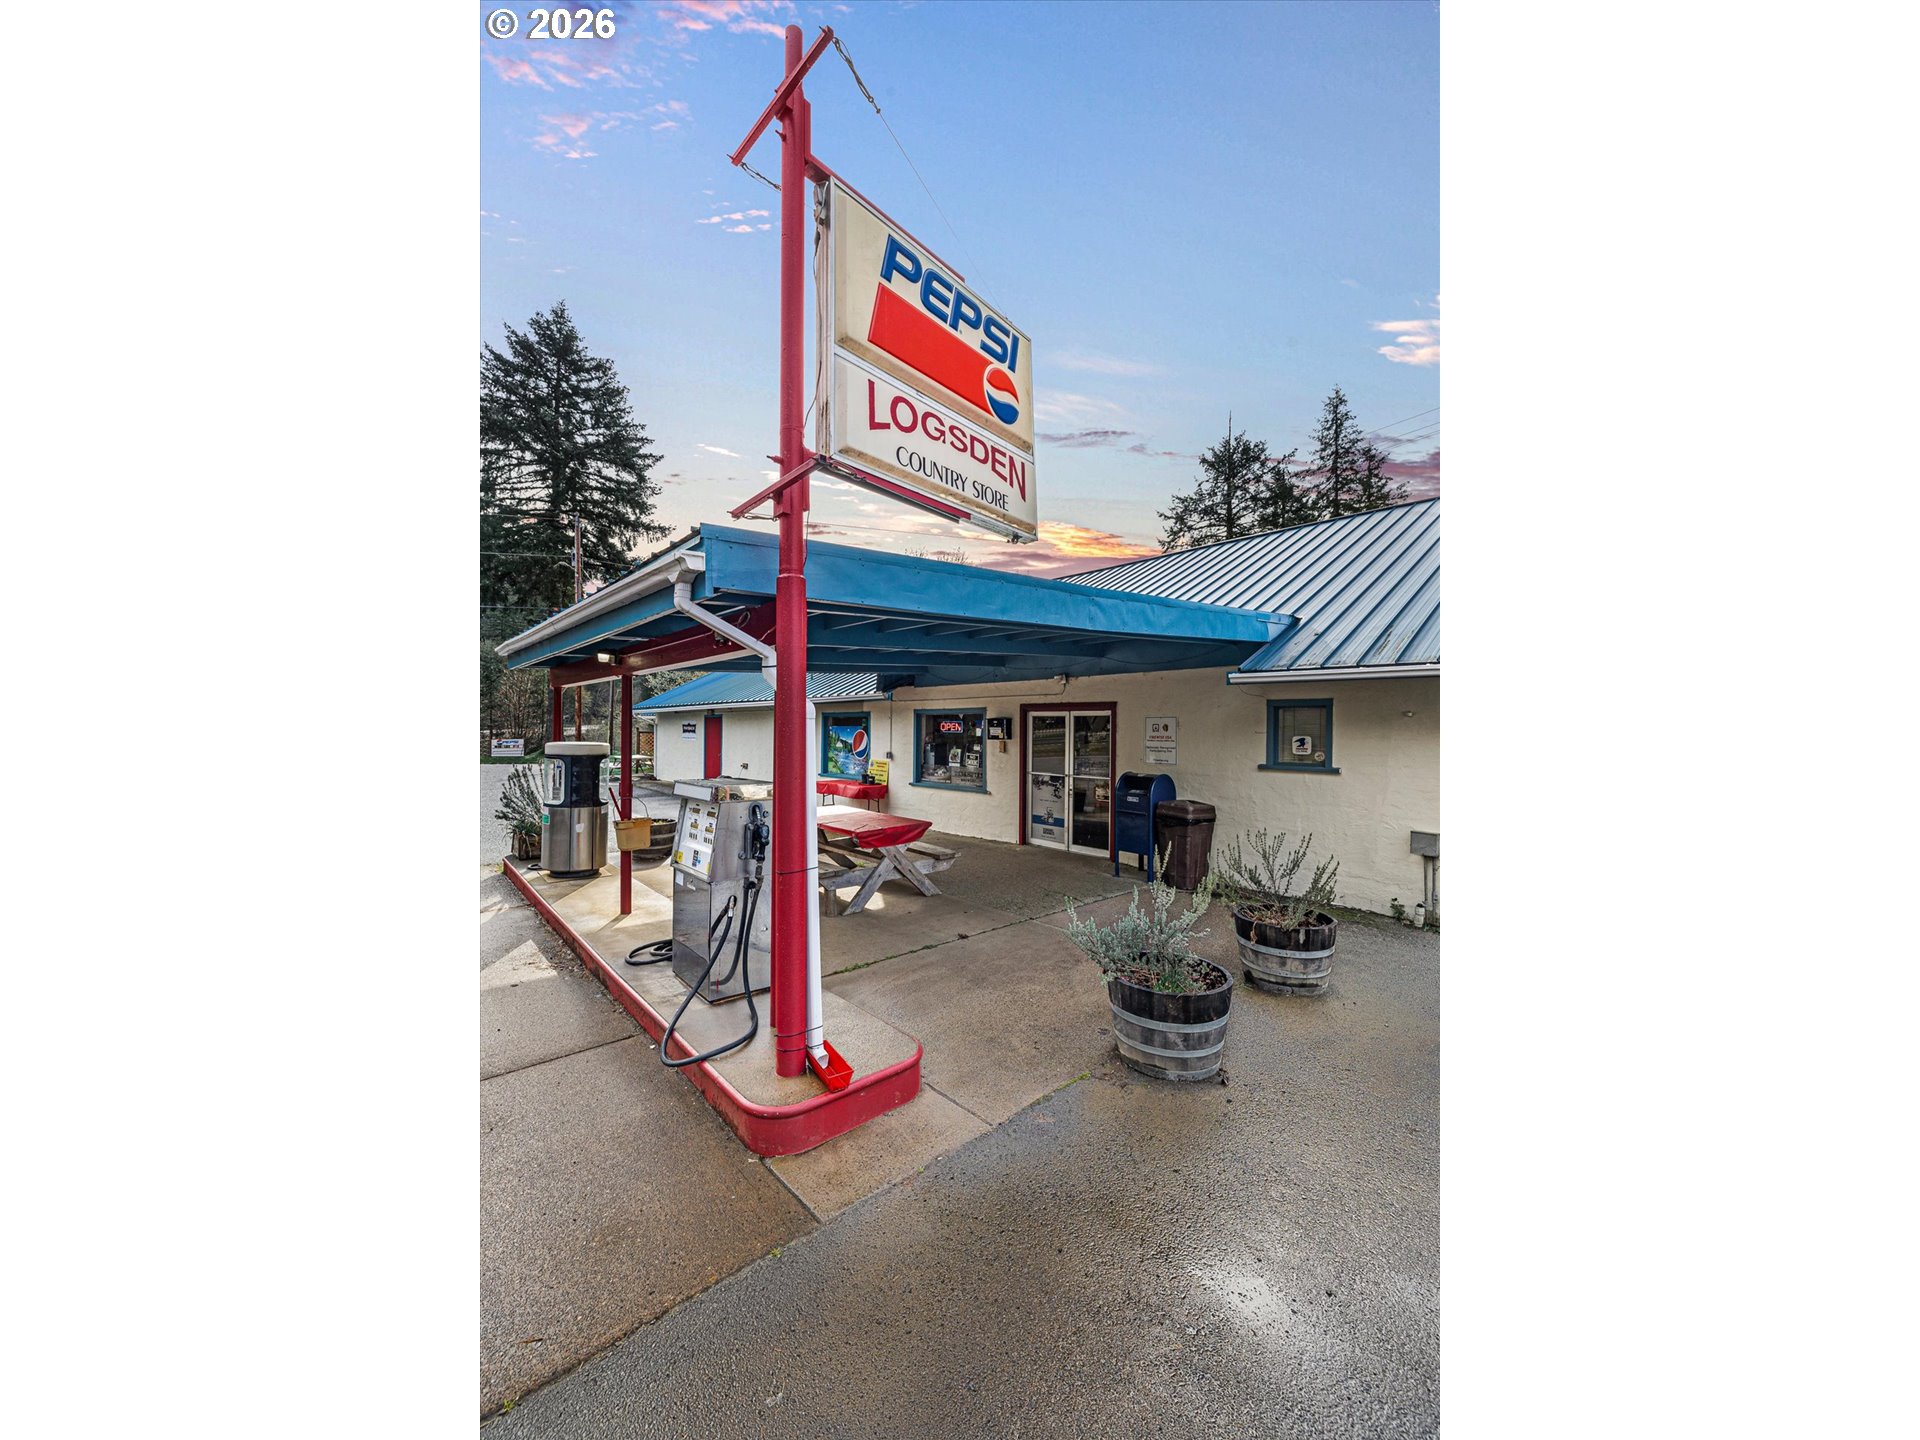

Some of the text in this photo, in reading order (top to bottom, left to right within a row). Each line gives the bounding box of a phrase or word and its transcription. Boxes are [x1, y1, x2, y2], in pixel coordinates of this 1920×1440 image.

[880, 234, 1020, 374] PEPSI
[868, 378, 1027, 503] LOGSDEN
[896, 446, 1009, 512] COUNTRY STORE
[940, 721, 962, 732] OPEN
